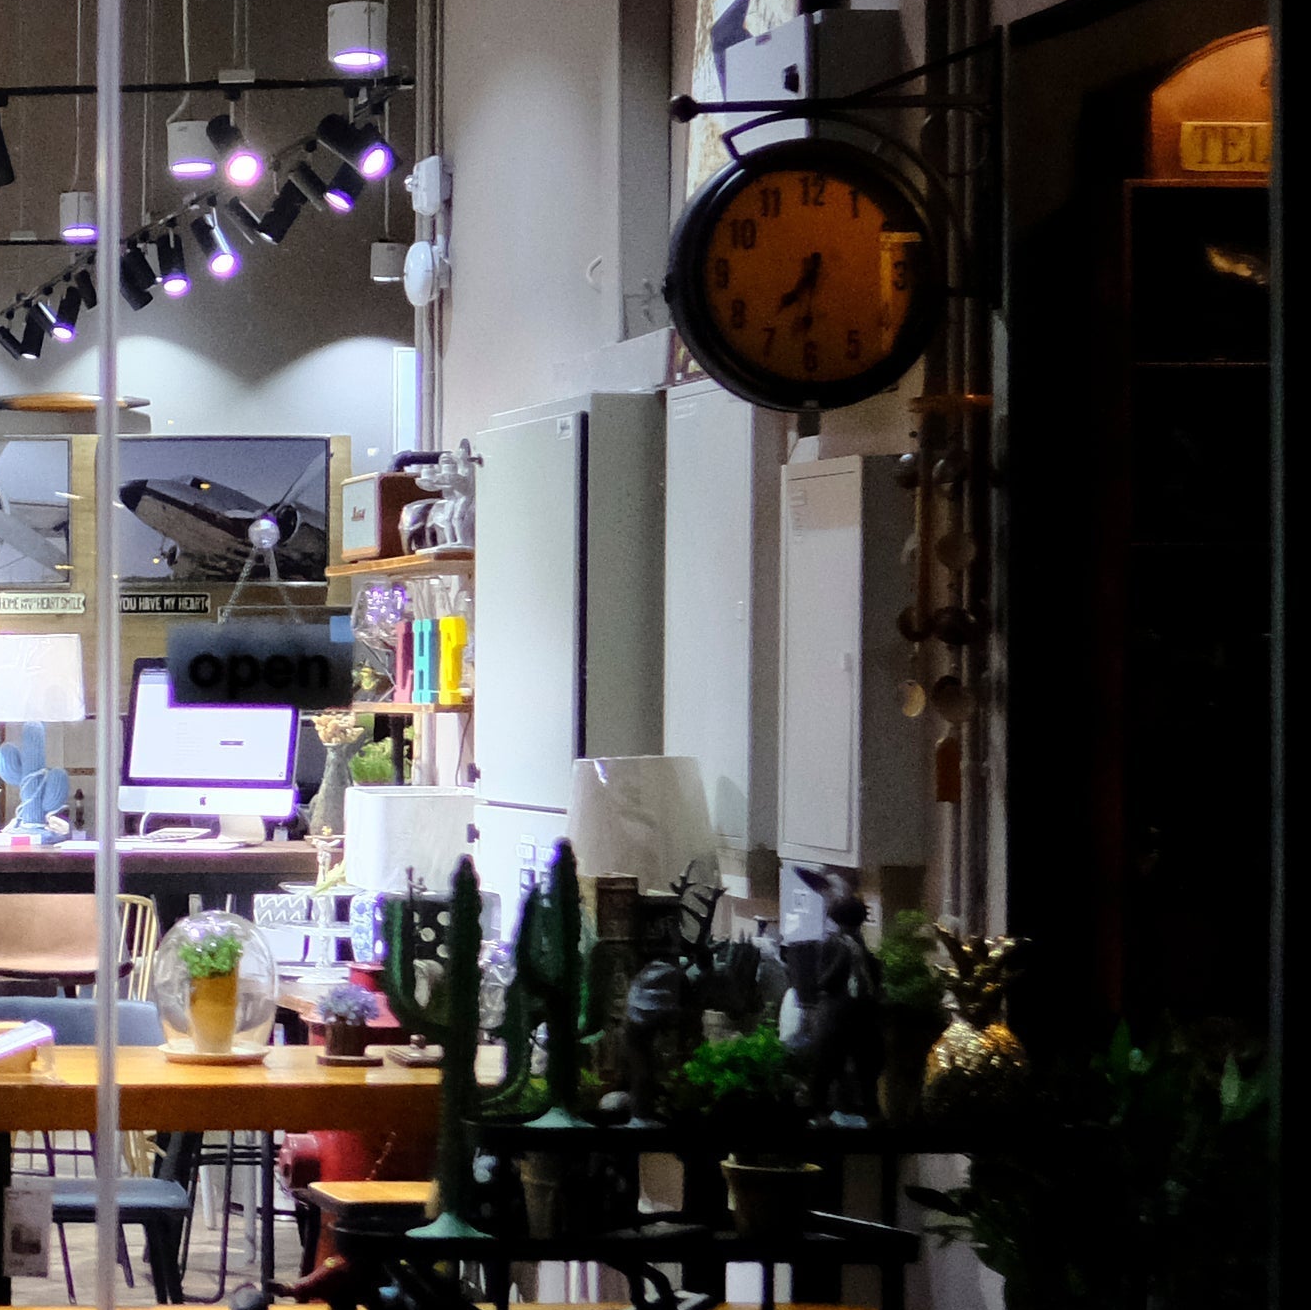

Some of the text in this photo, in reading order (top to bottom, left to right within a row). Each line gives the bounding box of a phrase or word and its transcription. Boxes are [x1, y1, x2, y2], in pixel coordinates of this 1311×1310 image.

[760, 188, 781, 218] 11
[799, 175, 827, 207] 12
[731, 218, 757, 250] 10
[714, 257, 730, 289] 9
[762, 327, 775, 358] 7
[138, 597, 162, 611] HAVE
[163, 597, 176, 611] MY
[178, 597, 207, 611] HEART
[189, 652, 331, 700] open
